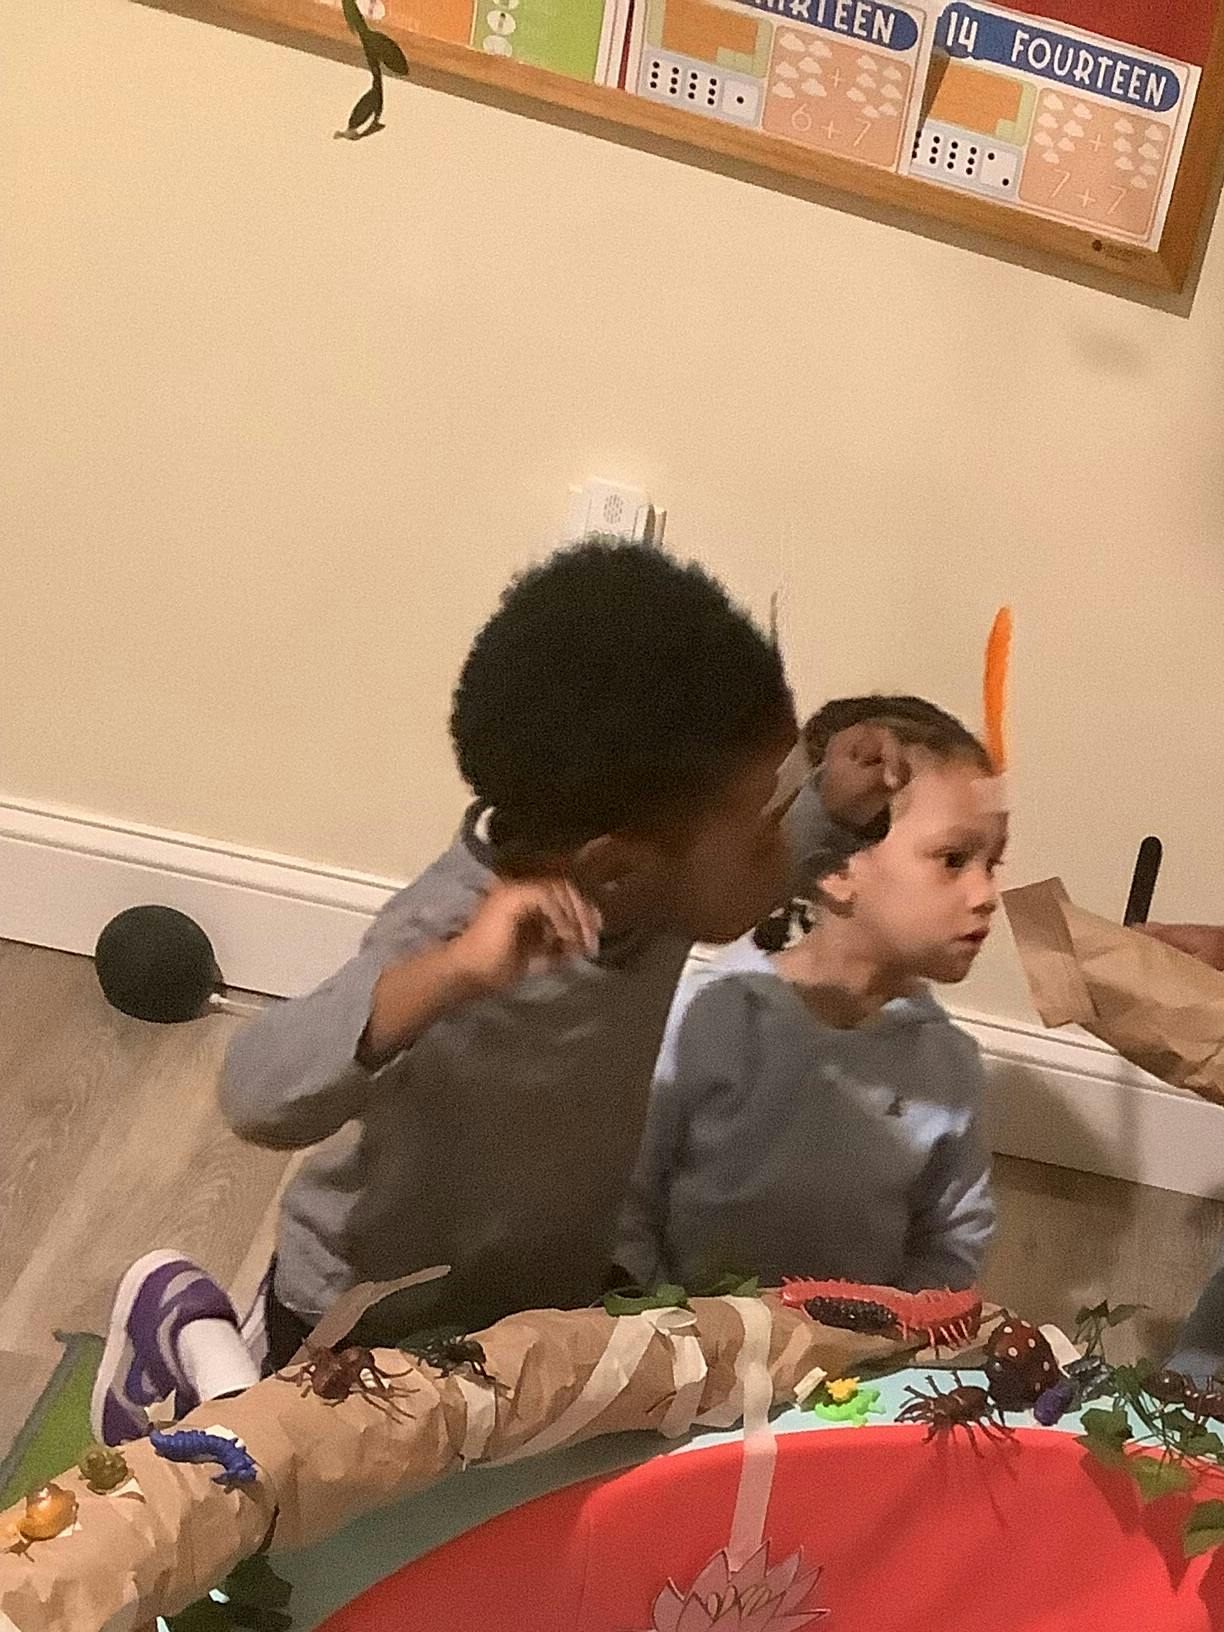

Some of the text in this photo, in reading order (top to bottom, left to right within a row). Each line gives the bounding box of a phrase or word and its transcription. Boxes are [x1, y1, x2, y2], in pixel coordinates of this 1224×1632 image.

[946, 11, 1167, 107] 14 FOURTEEN
[791, 103, 812, 132] 6
[852, 117, 872, 147] 7
[1050, 168, 1071, 198] 7
[1107, 184, 1128, 215] 7
